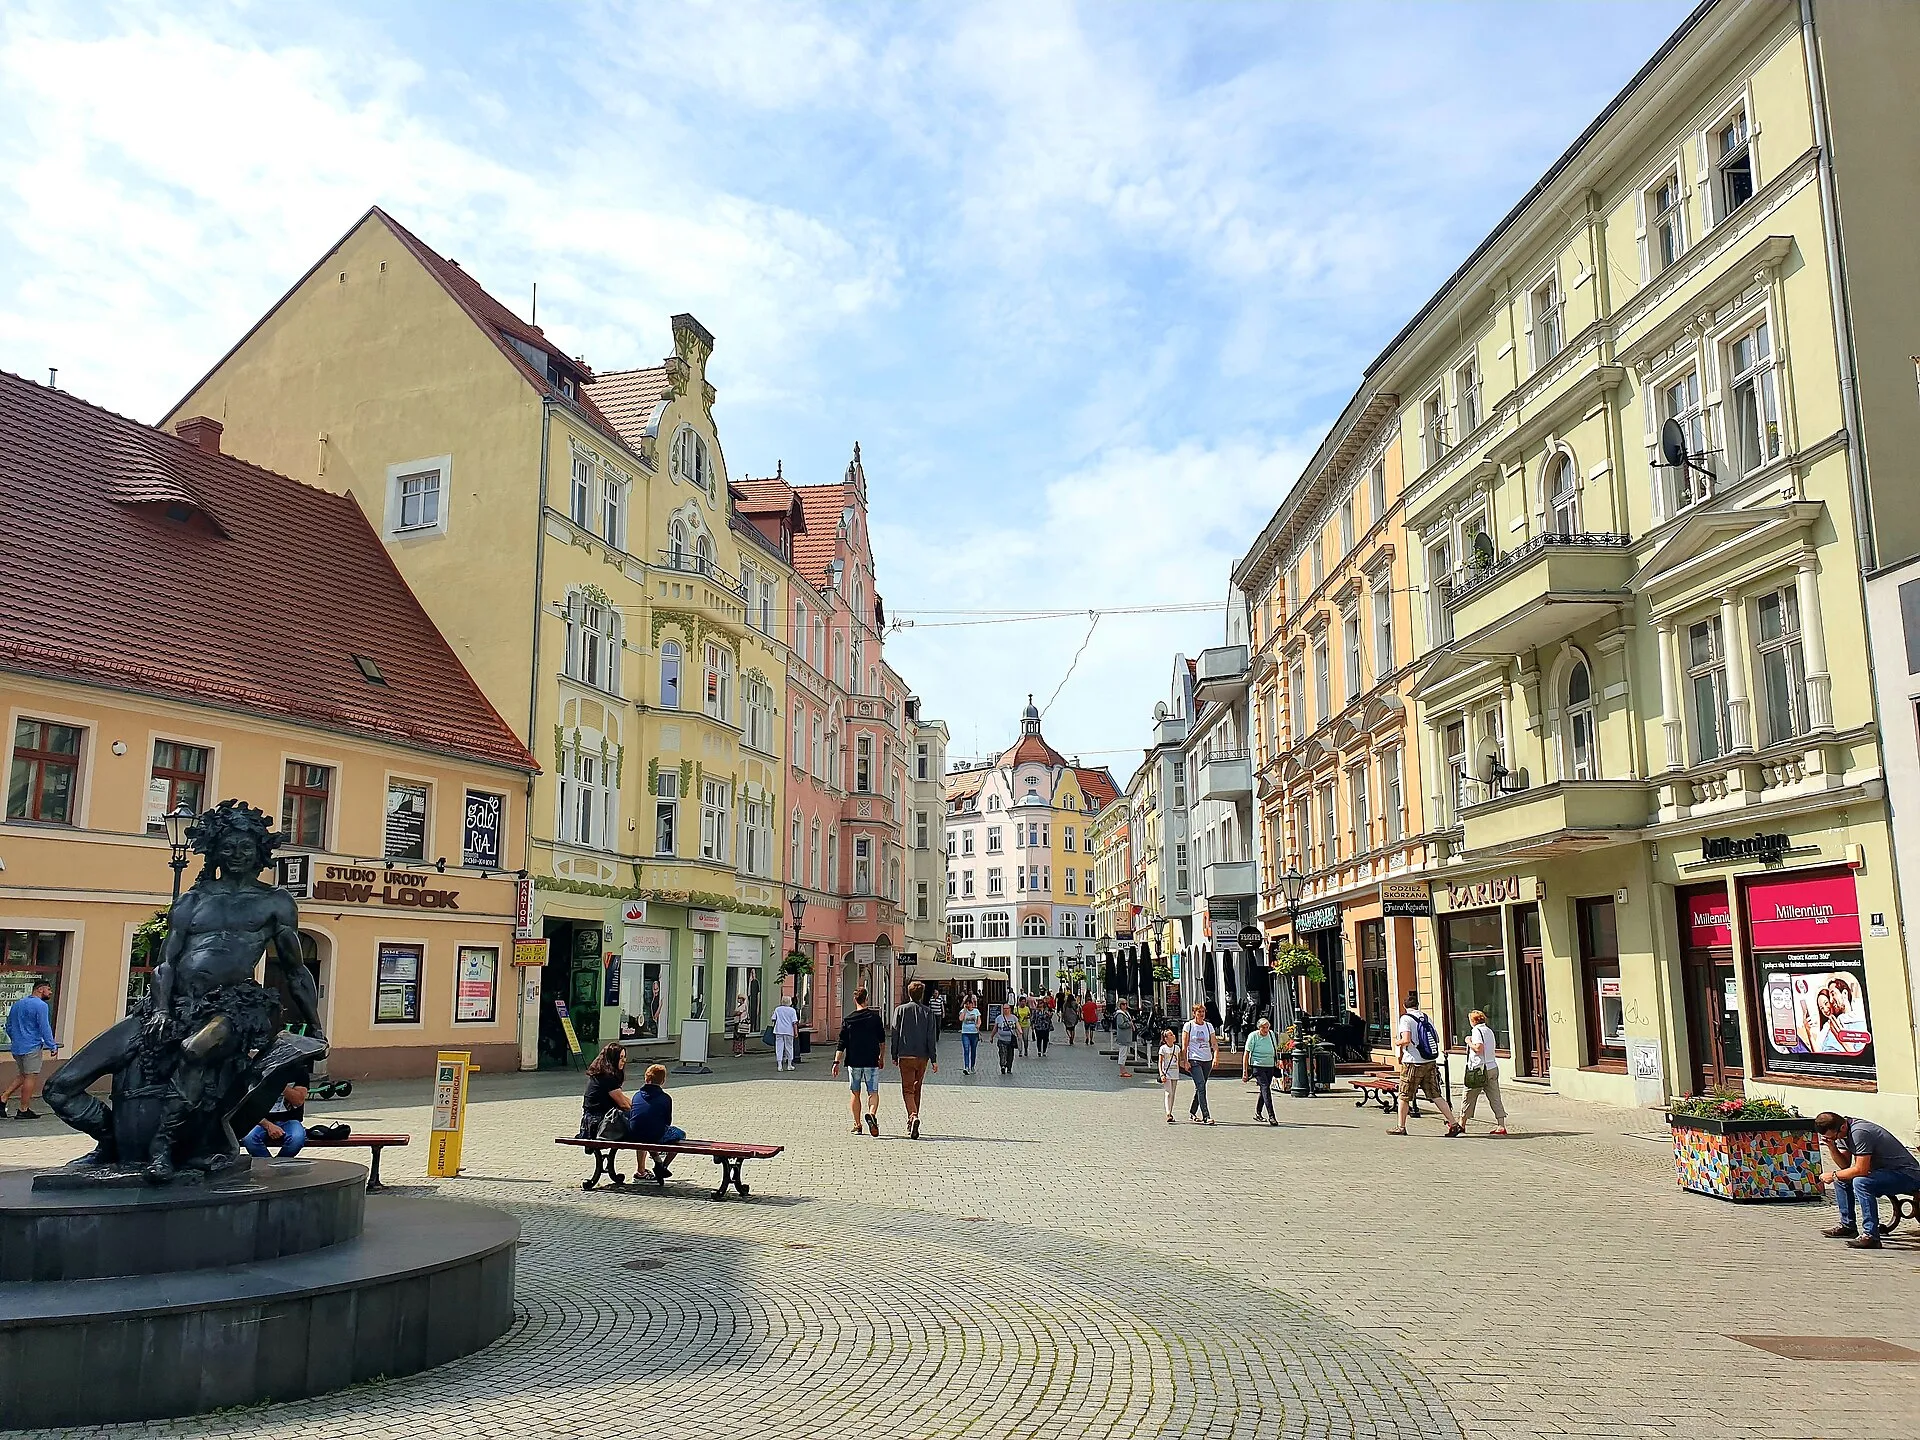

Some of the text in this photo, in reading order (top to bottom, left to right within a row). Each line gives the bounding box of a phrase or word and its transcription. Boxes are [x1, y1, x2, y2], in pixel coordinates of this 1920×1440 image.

[1700, 832, 1791, 860] Millennium
[326, 866, 429, 888] STUDIO URODY
[519, 881, 529, 924] KANTOR
[1445, 874, 1521, 910] KARIBU
[1774, 903, 1835, 920] Millennium
[1815, 916, 1829, 925] bank
